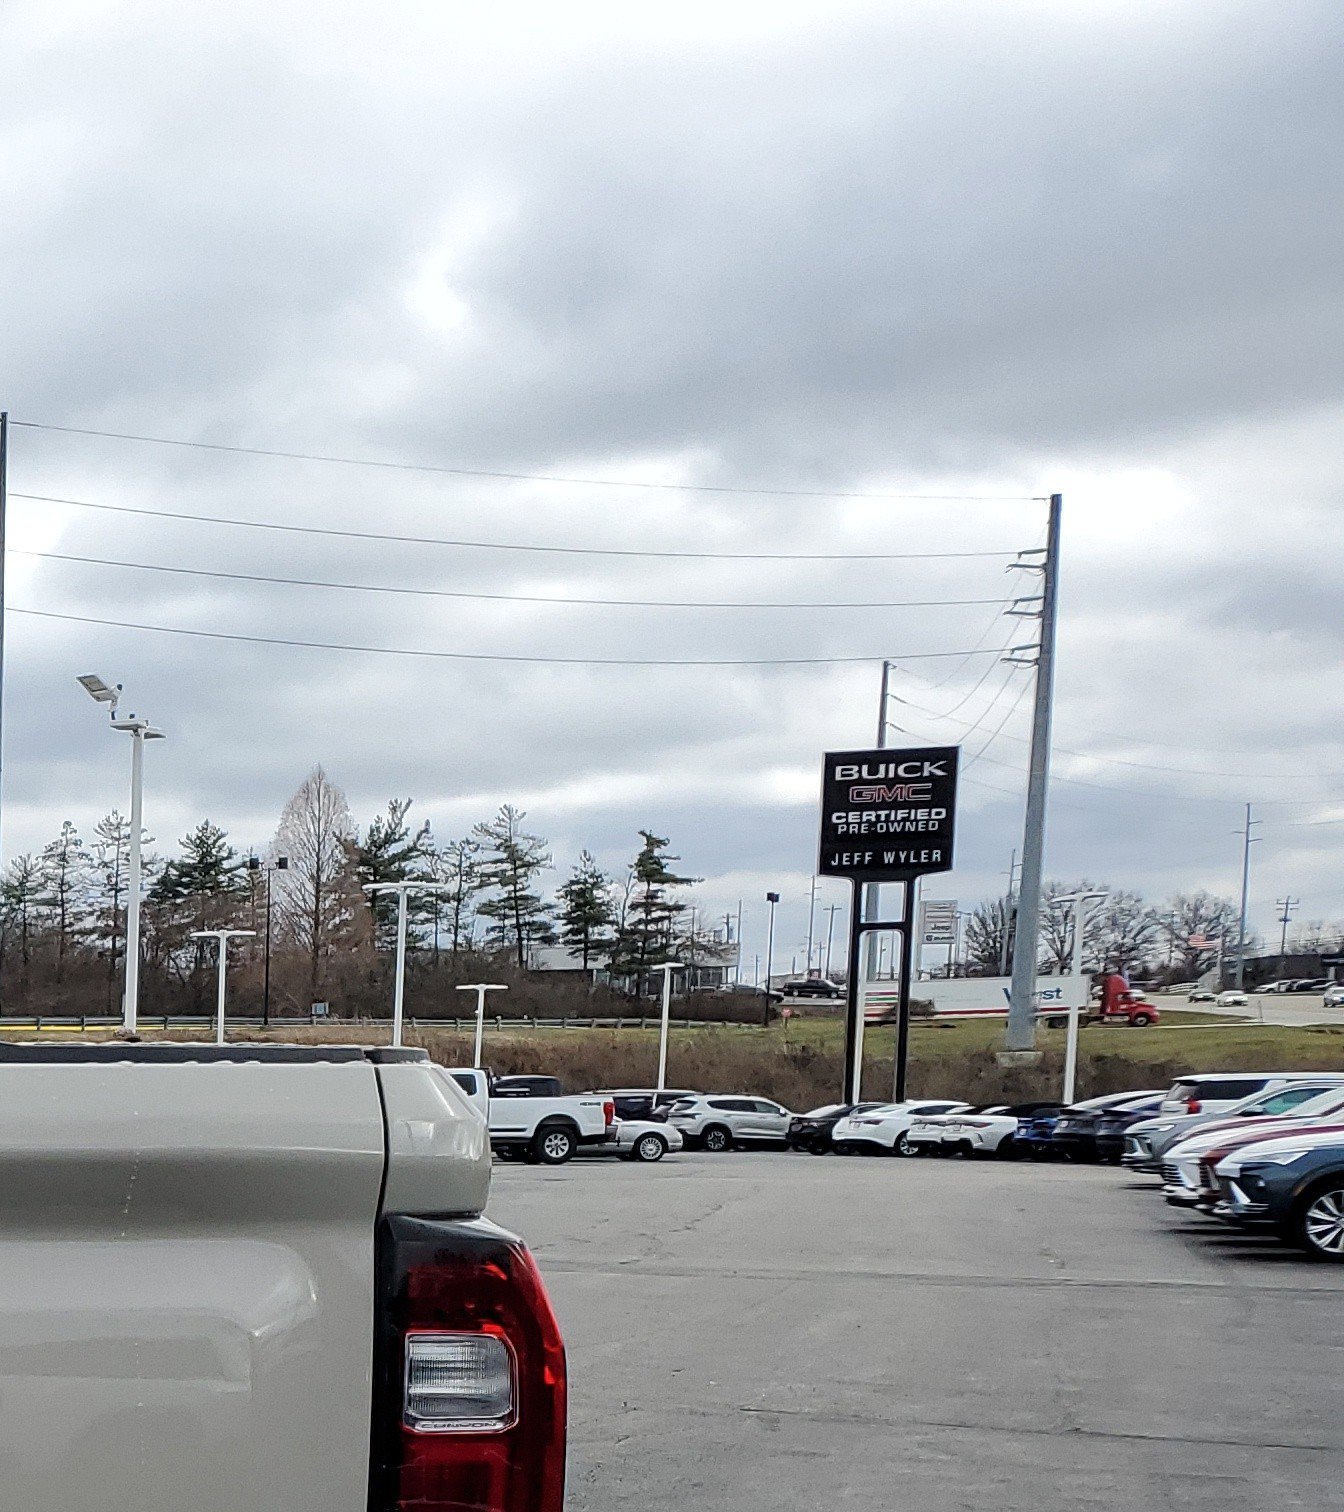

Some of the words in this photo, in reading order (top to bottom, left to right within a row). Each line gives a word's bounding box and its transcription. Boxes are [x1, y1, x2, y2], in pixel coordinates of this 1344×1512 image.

[834, 760, 948, 781] BUICK
[848, 782, 933, 804] GMC
[831, 807, 948, 824] CERTIFIED
[837, 820, 940, 835] PRE-OWNED
[830, 851, 874, 866] JEFF
[883, 849, 942, 864] WYLER
